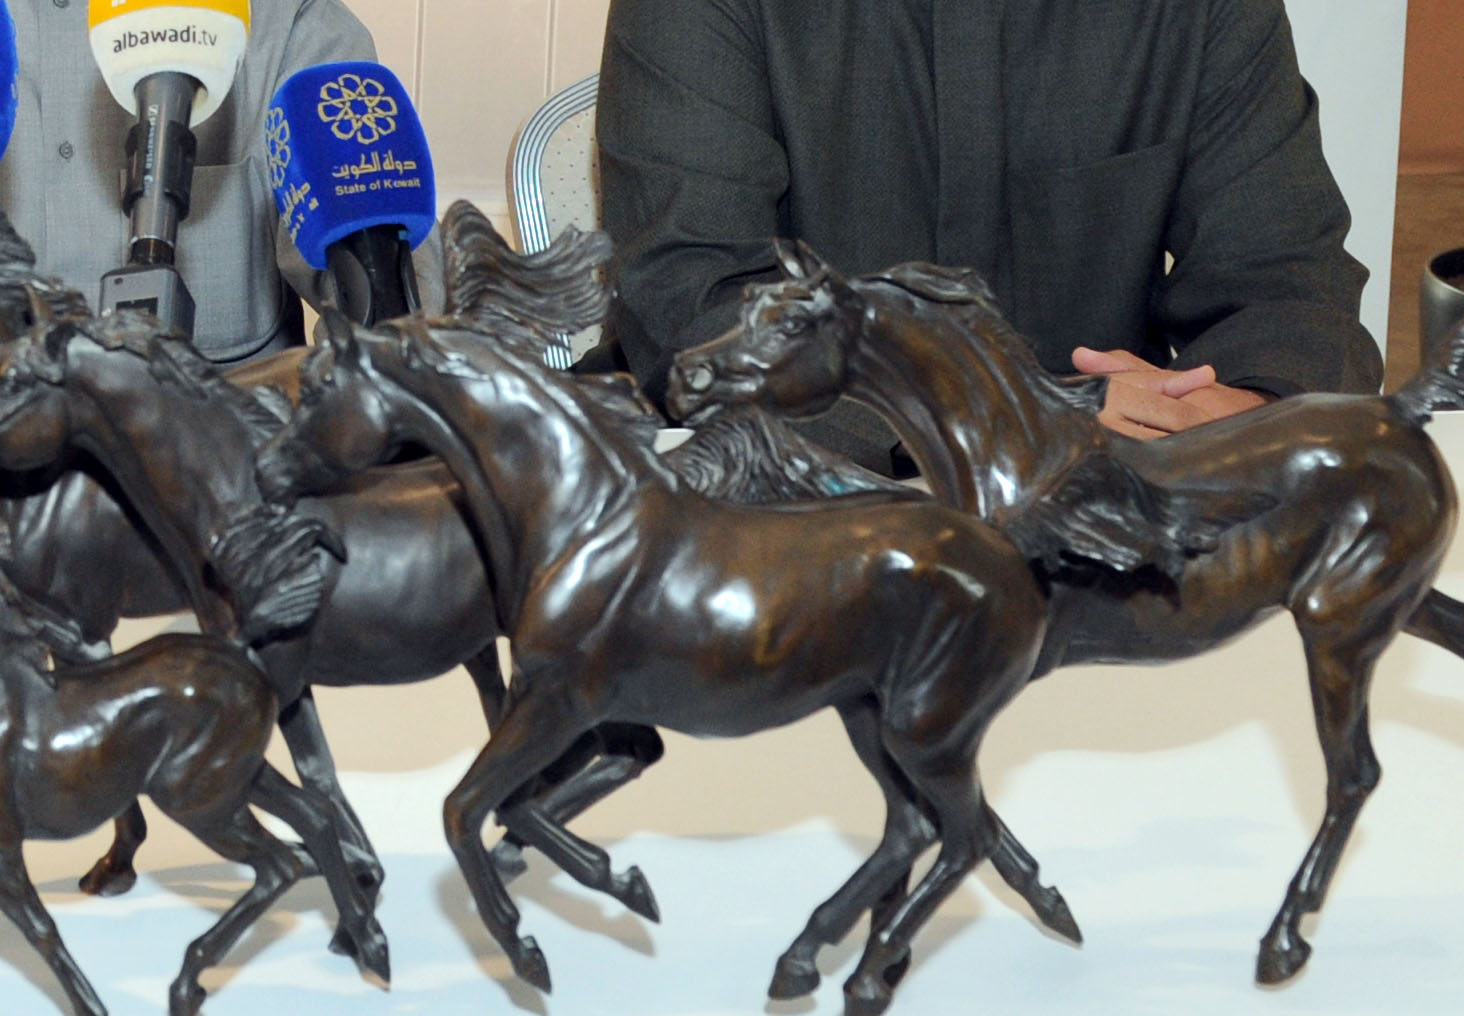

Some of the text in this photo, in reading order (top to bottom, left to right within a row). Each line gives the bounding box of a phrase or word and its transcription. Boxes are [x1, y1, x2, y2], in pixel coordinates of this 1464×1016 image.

[113, 25, 218, 52] albawadi.tv
[332, 150, 418, 180] دولة الكويت
[335, 182, 367, 196] State
[369, 179, 381, 191] of
